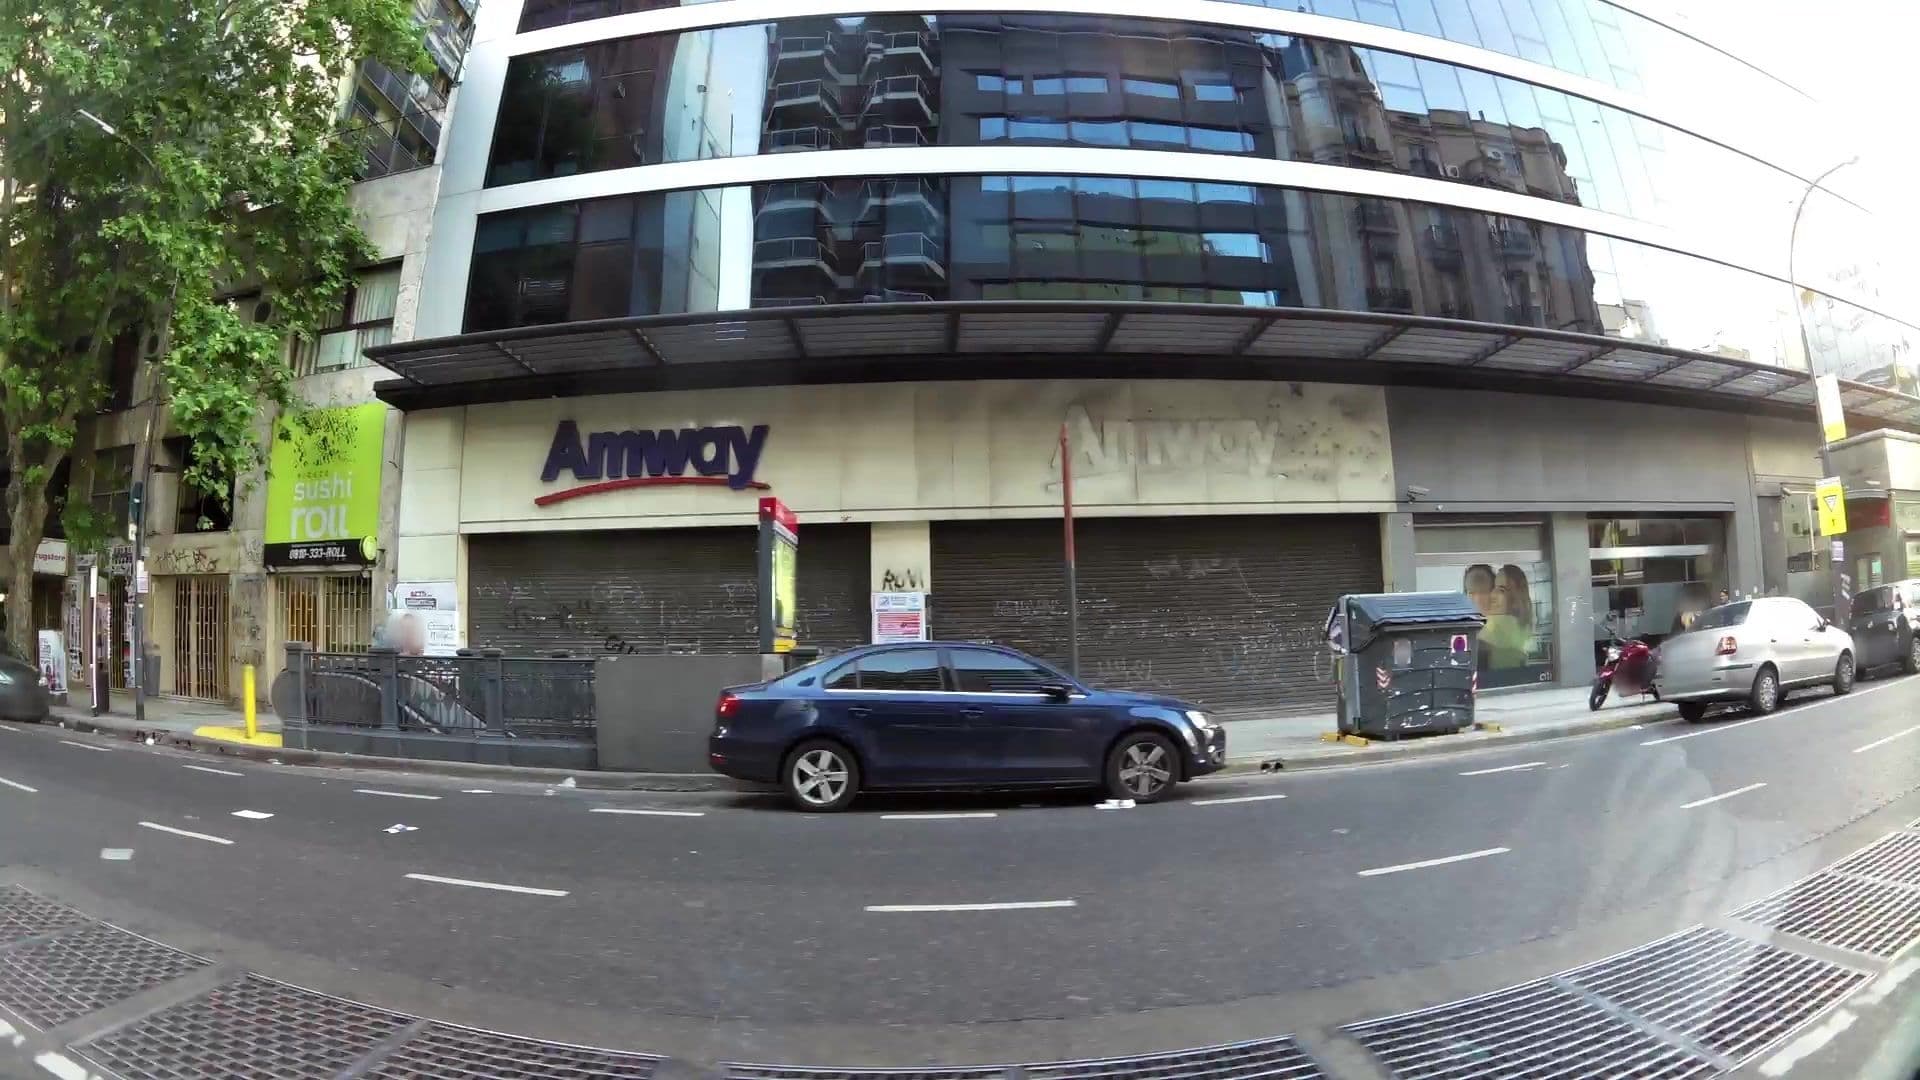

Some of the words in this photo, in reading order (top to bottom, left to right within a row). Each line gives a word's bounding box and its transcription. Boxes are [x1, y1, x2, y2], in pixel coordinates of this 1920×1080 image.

[541, 420, 769, 490] Amway
[293, 471, 352, 501] sushi
[289, 504, 349, 540] roll
